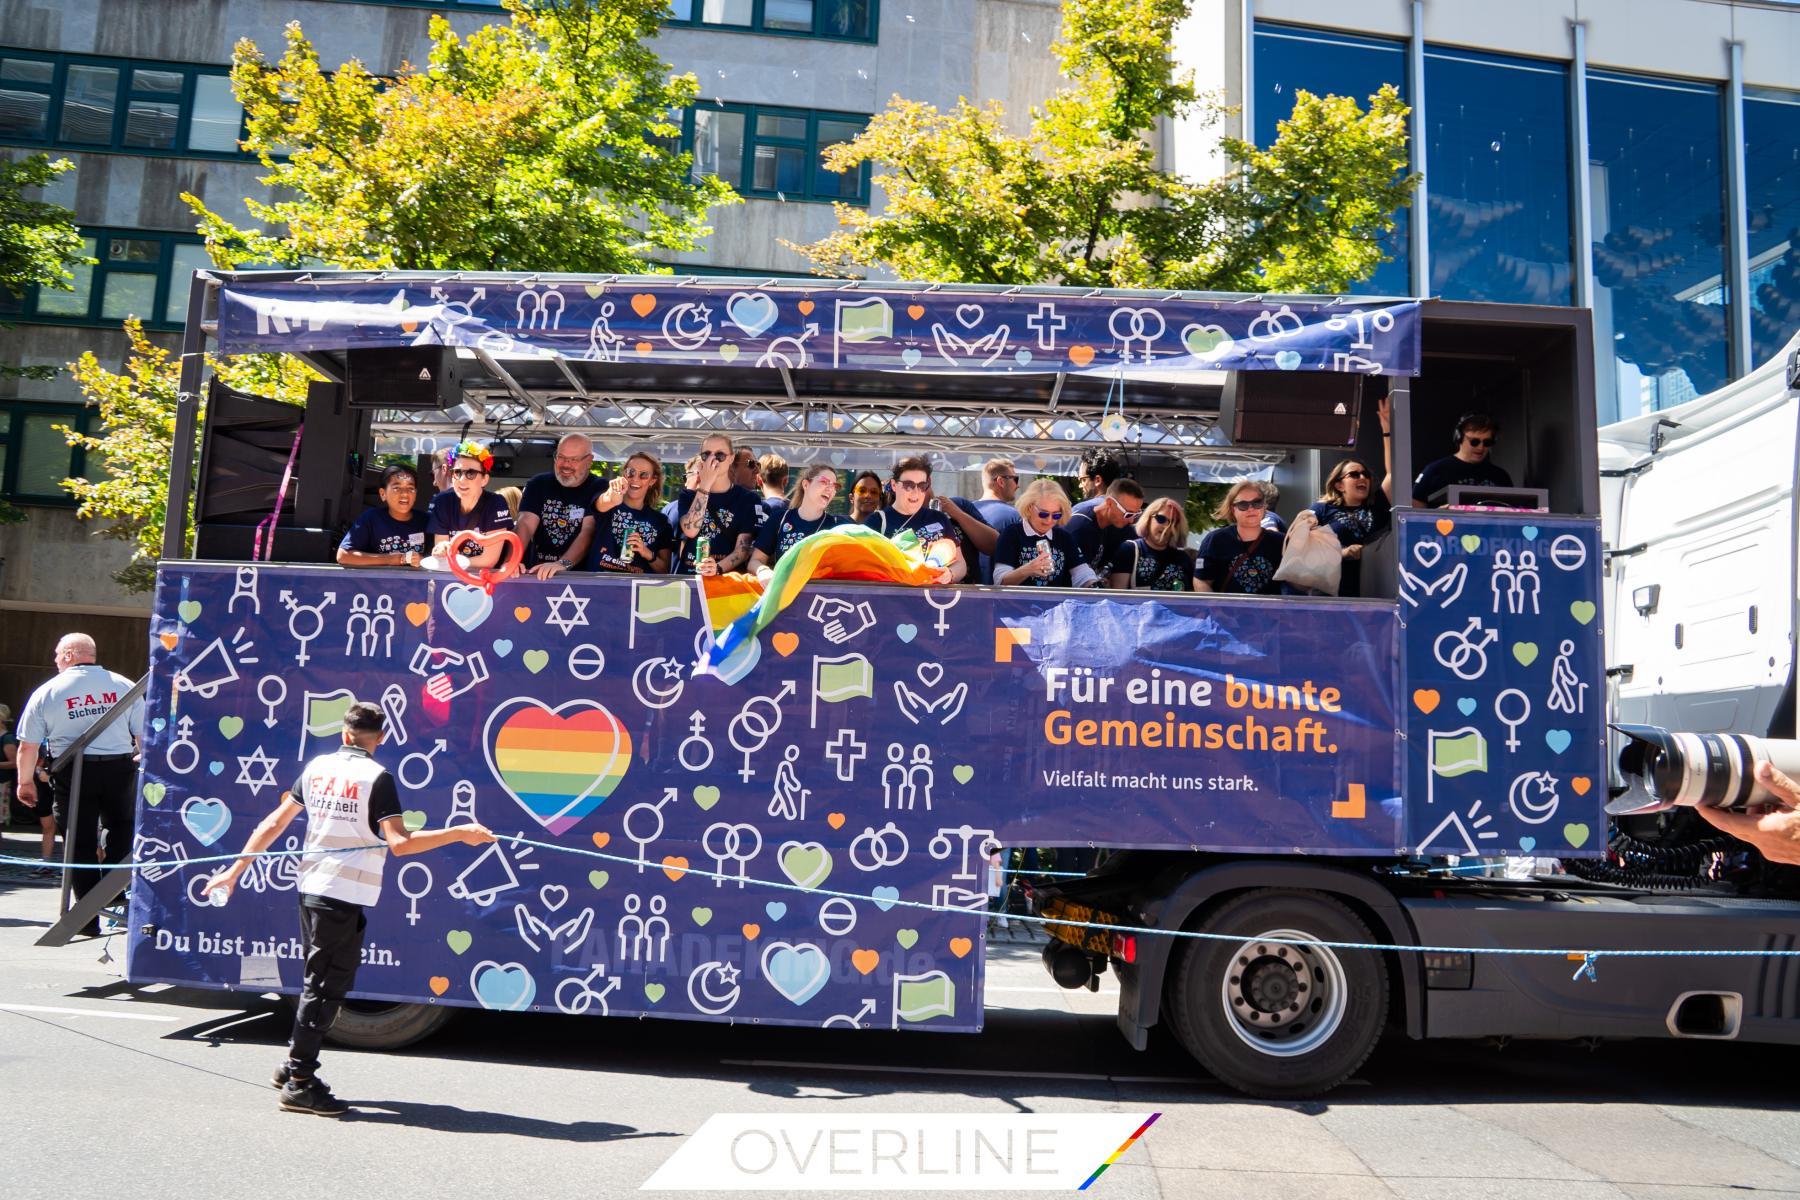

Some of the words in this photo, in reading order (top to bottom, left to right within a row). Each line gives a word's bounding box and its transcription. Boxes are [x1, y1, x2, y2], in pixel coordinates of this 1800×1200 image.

[1046, 667, 1115, 703] Für
[1126, 668, 1212, 707] eine
[1225, 673, 1342, 712] bunte
[68, 705, 112, 720] Sicherh
[1044, 709, 1338, 754] Gemeinschaft.
[1043, 770, 1107, 788] Vielfalt
[1112, 772, 1167, 789] macht
[1172, 777, 1203, 790] uns
[1208, 775, 1259, 791] stark.
[155, 929, 190, 952] Du
[198, 932, 245, 956] bist
[251, 936, 304, 960] nich
